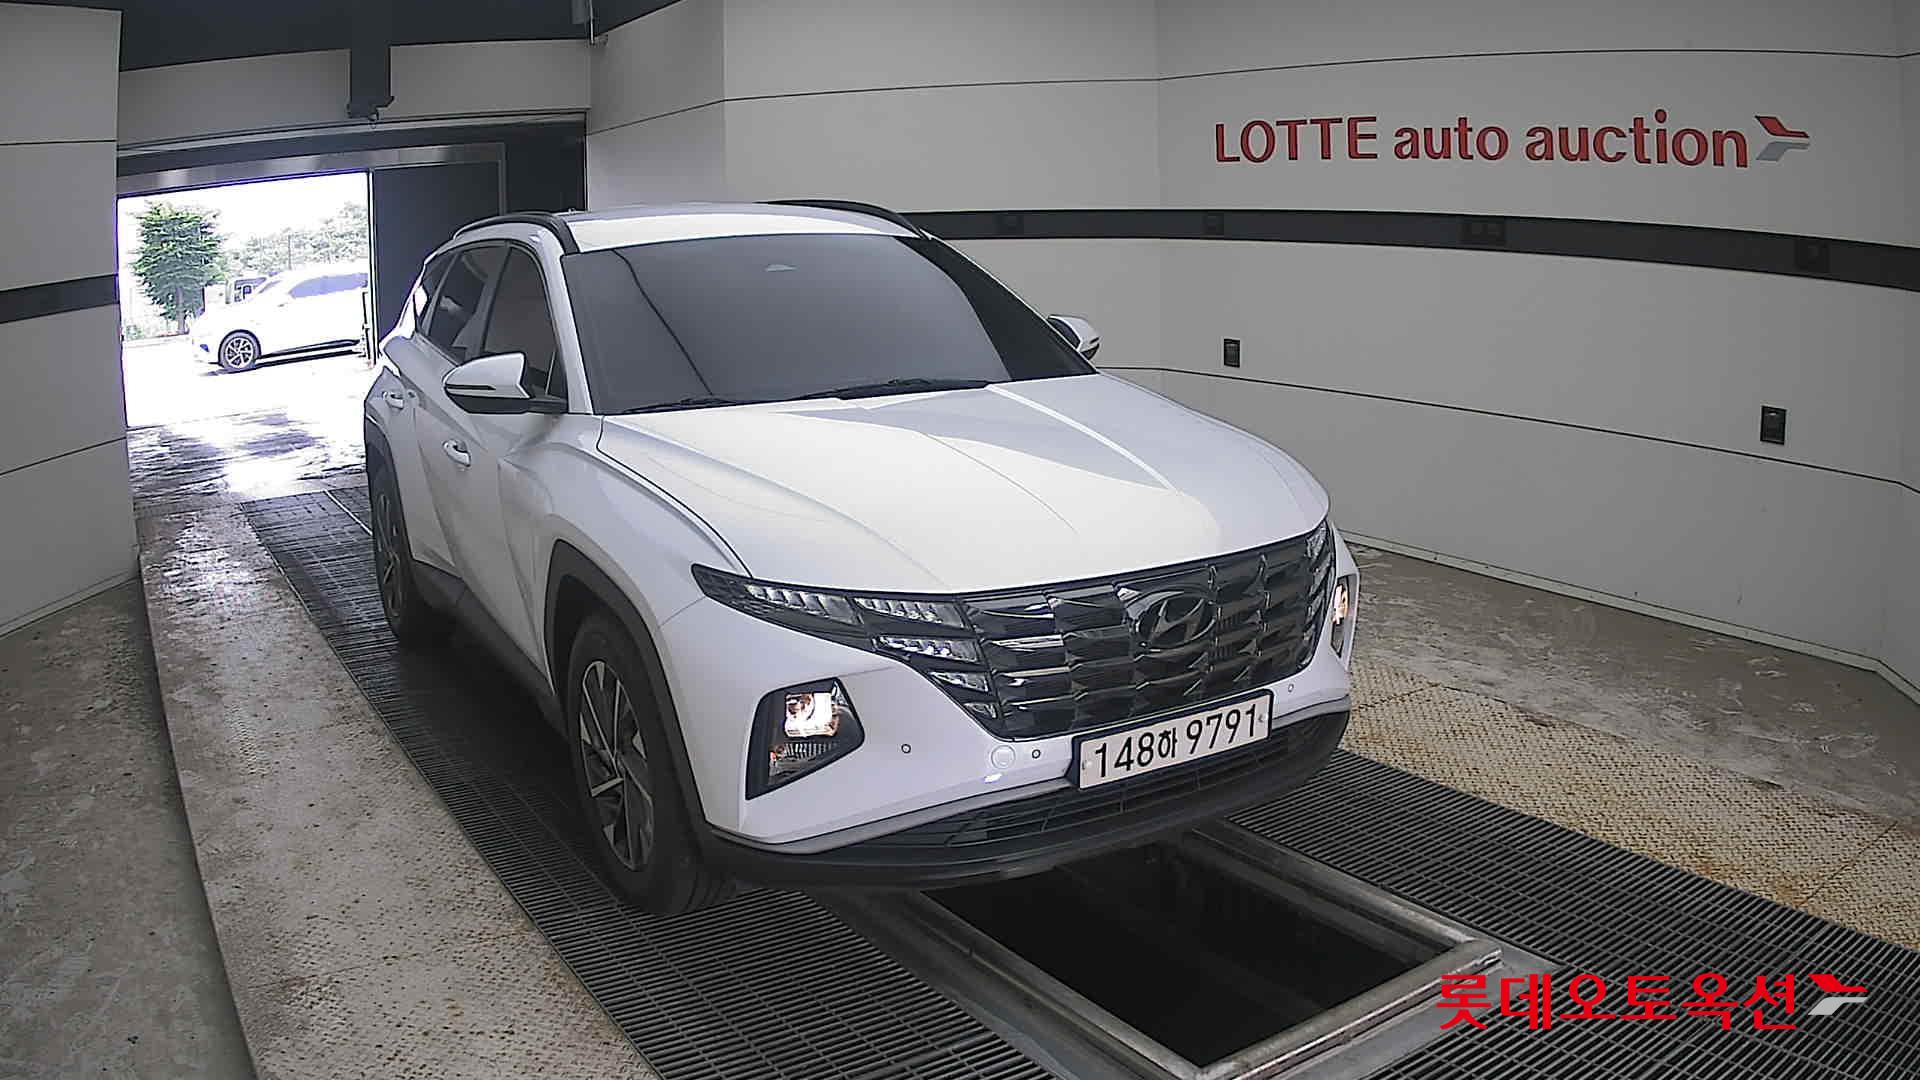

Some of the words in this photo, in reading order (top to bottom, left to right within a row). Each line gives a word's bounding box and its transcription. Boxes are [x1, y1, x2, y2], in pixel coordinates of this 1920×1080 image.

[1215, 116, 1378, 163] LOTTE
[1394, 117, 1508, 160] auto
[1525, 108, 1748, 168] auction
